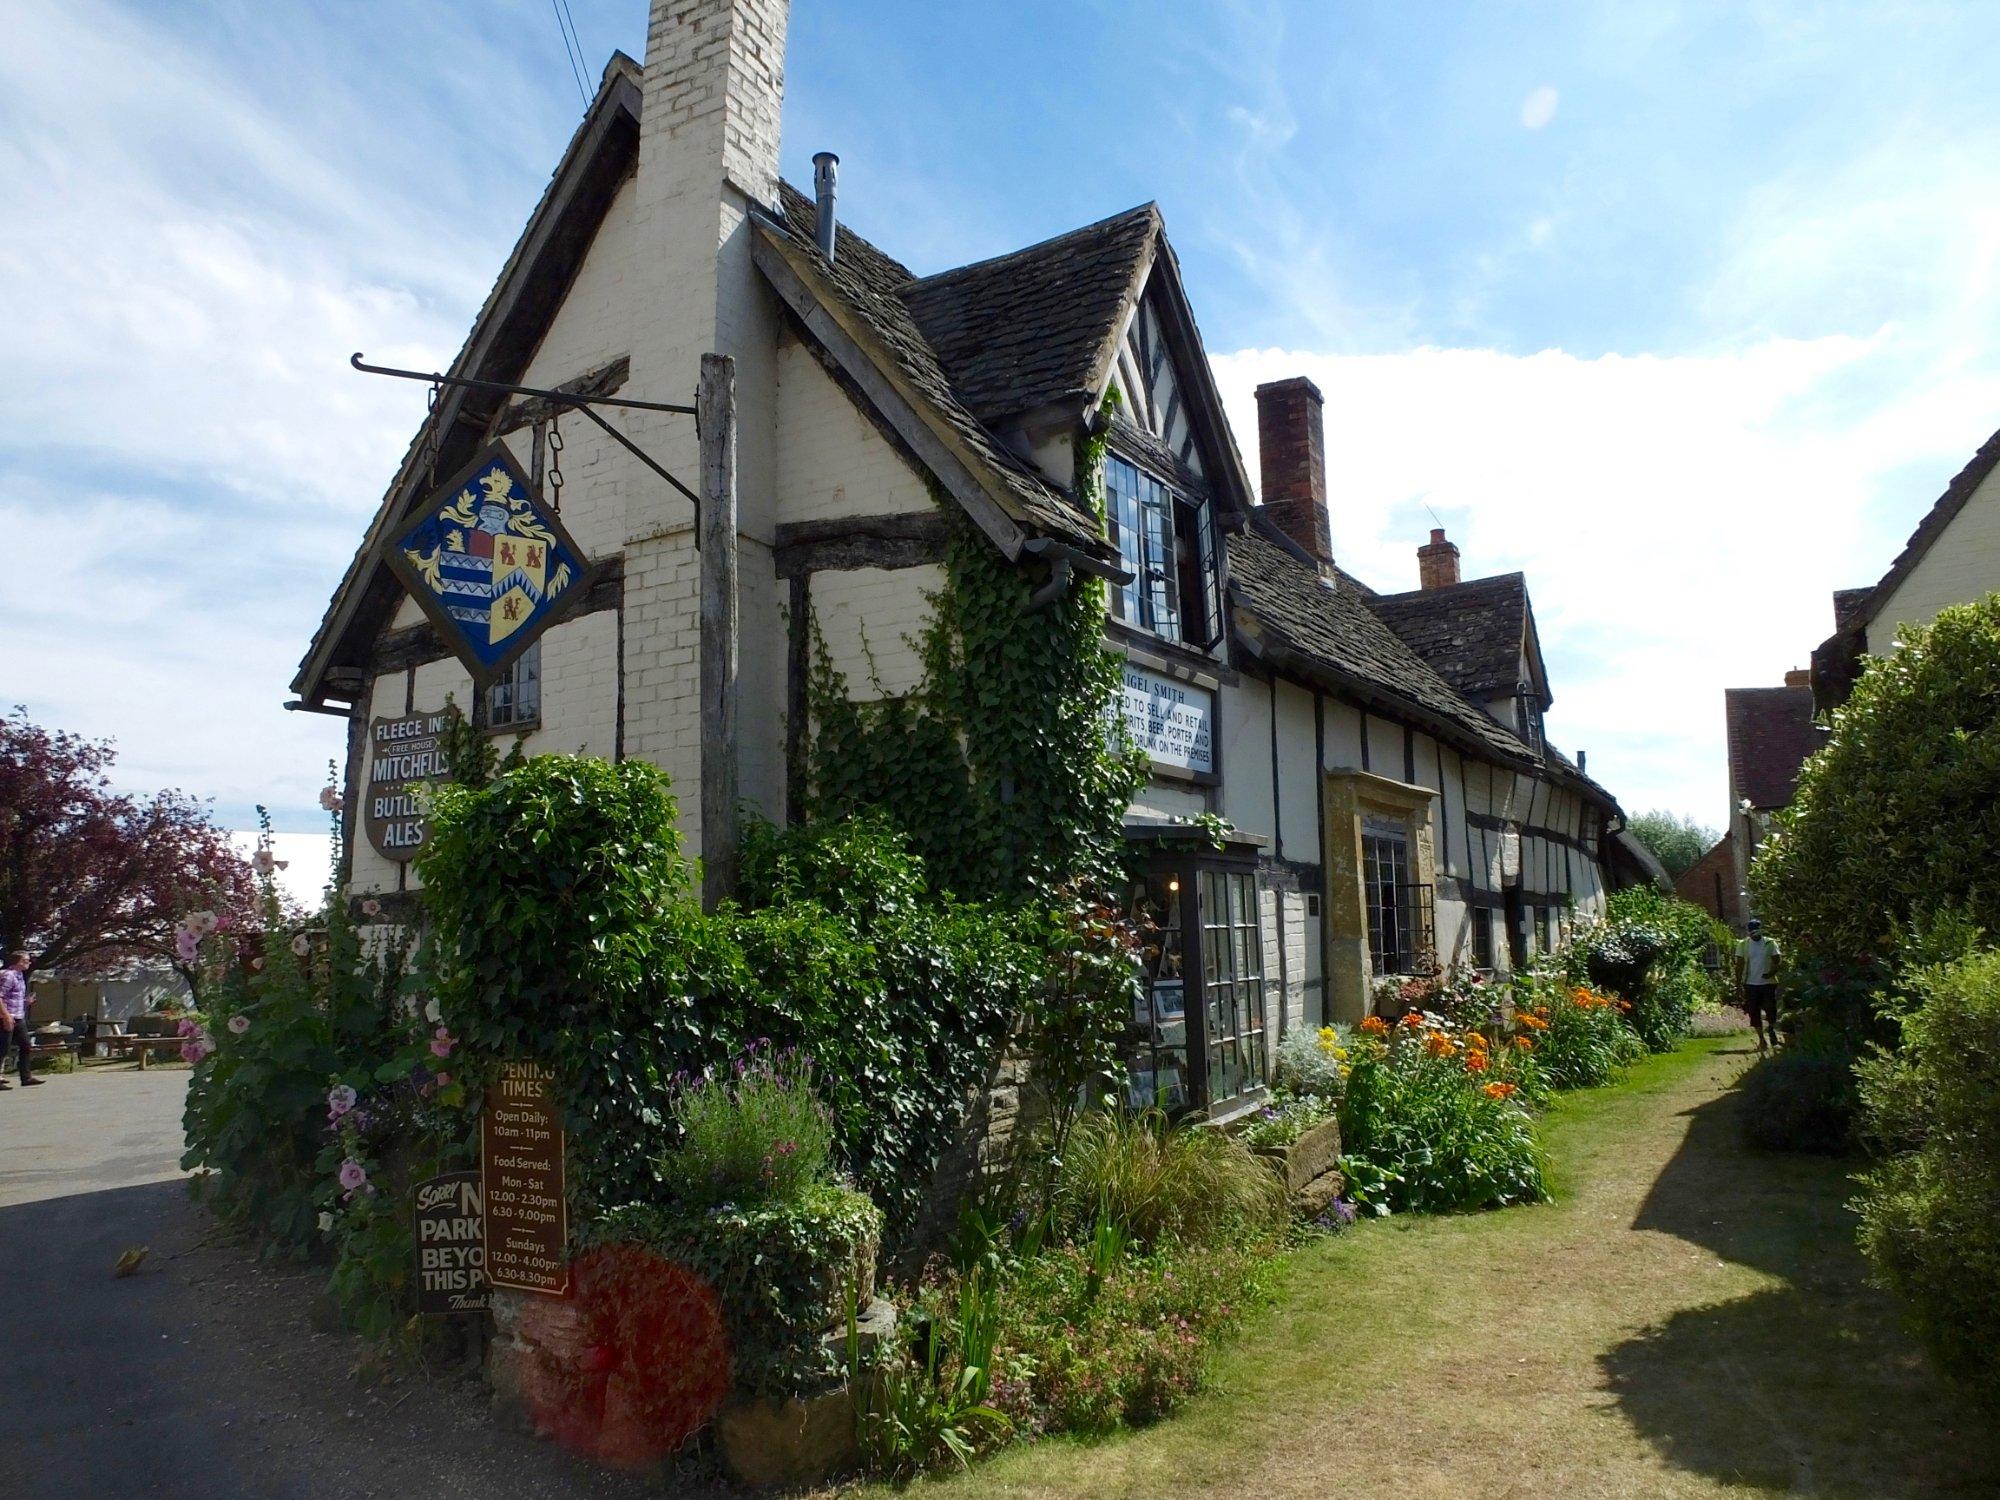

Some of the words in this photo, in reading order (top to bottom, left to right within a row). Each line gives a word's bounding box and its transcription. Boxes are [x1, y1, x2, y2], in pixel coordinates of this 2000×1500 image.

[1154, 682, 1185, 704] SMITH
[1134, 698, 1144, 713] TO
[1147, 703, 1165, 719] SELL
[1167, 709, 1182, 725] AND
[1186, 715, 1208, 732] RETAIL
[376, 719, 423, 741] FLEECE
[1168, 726, 1192, 743] PORTER
[1195, 733, 1209, 748] AND
[392, 744, 409, 753] FREE
[412, 740, 433, 751] HOUSE
[1135, 733, 1157, 751] DRUNK
[1159, 740, 1169, 753] ON
[1170, 742, 1182, 757] THE
[1184, 746, 1210, 762] PREMISES
[373, 750, 450, 782] MITCHELLS
[373, 795, 419, 818] BUTLE
[382, 822, 424, 847] ALES
[501, 1080, 544, 1098] TIMES
[495, 1110, 520, 1124] Open
[521, 1111, 549, 1124] Daily:
[494, 1126, 519, 1137] 10am
[525, 1128, 550, 1141] 11pm
[494, 1155, 516, 1168] Food
[517, 1158, 552, 1171] Served:
[502, 1175, 522, 1188] Mon
[528, 1178, 544, 1190] Sat
[461, 1181, 483, 1216] N
[489, 1190, 516, 1202] 12.00
[521, 1193, 558, 1208] 2.30pm
[518, 1209, 556, 1224] 9.00pm
[420, 1217, 483, 1242] PARK
[506, 1237, 546, 1253] Sundays
[422, 1246, 484, 1269] BEYO
[491, 1250, 517, 1264] 12.00
[422, 1270, 469, 1291] THIS
[470, 1270, 485, 1289] P
[448, 1294, 486, 1309] Thank
